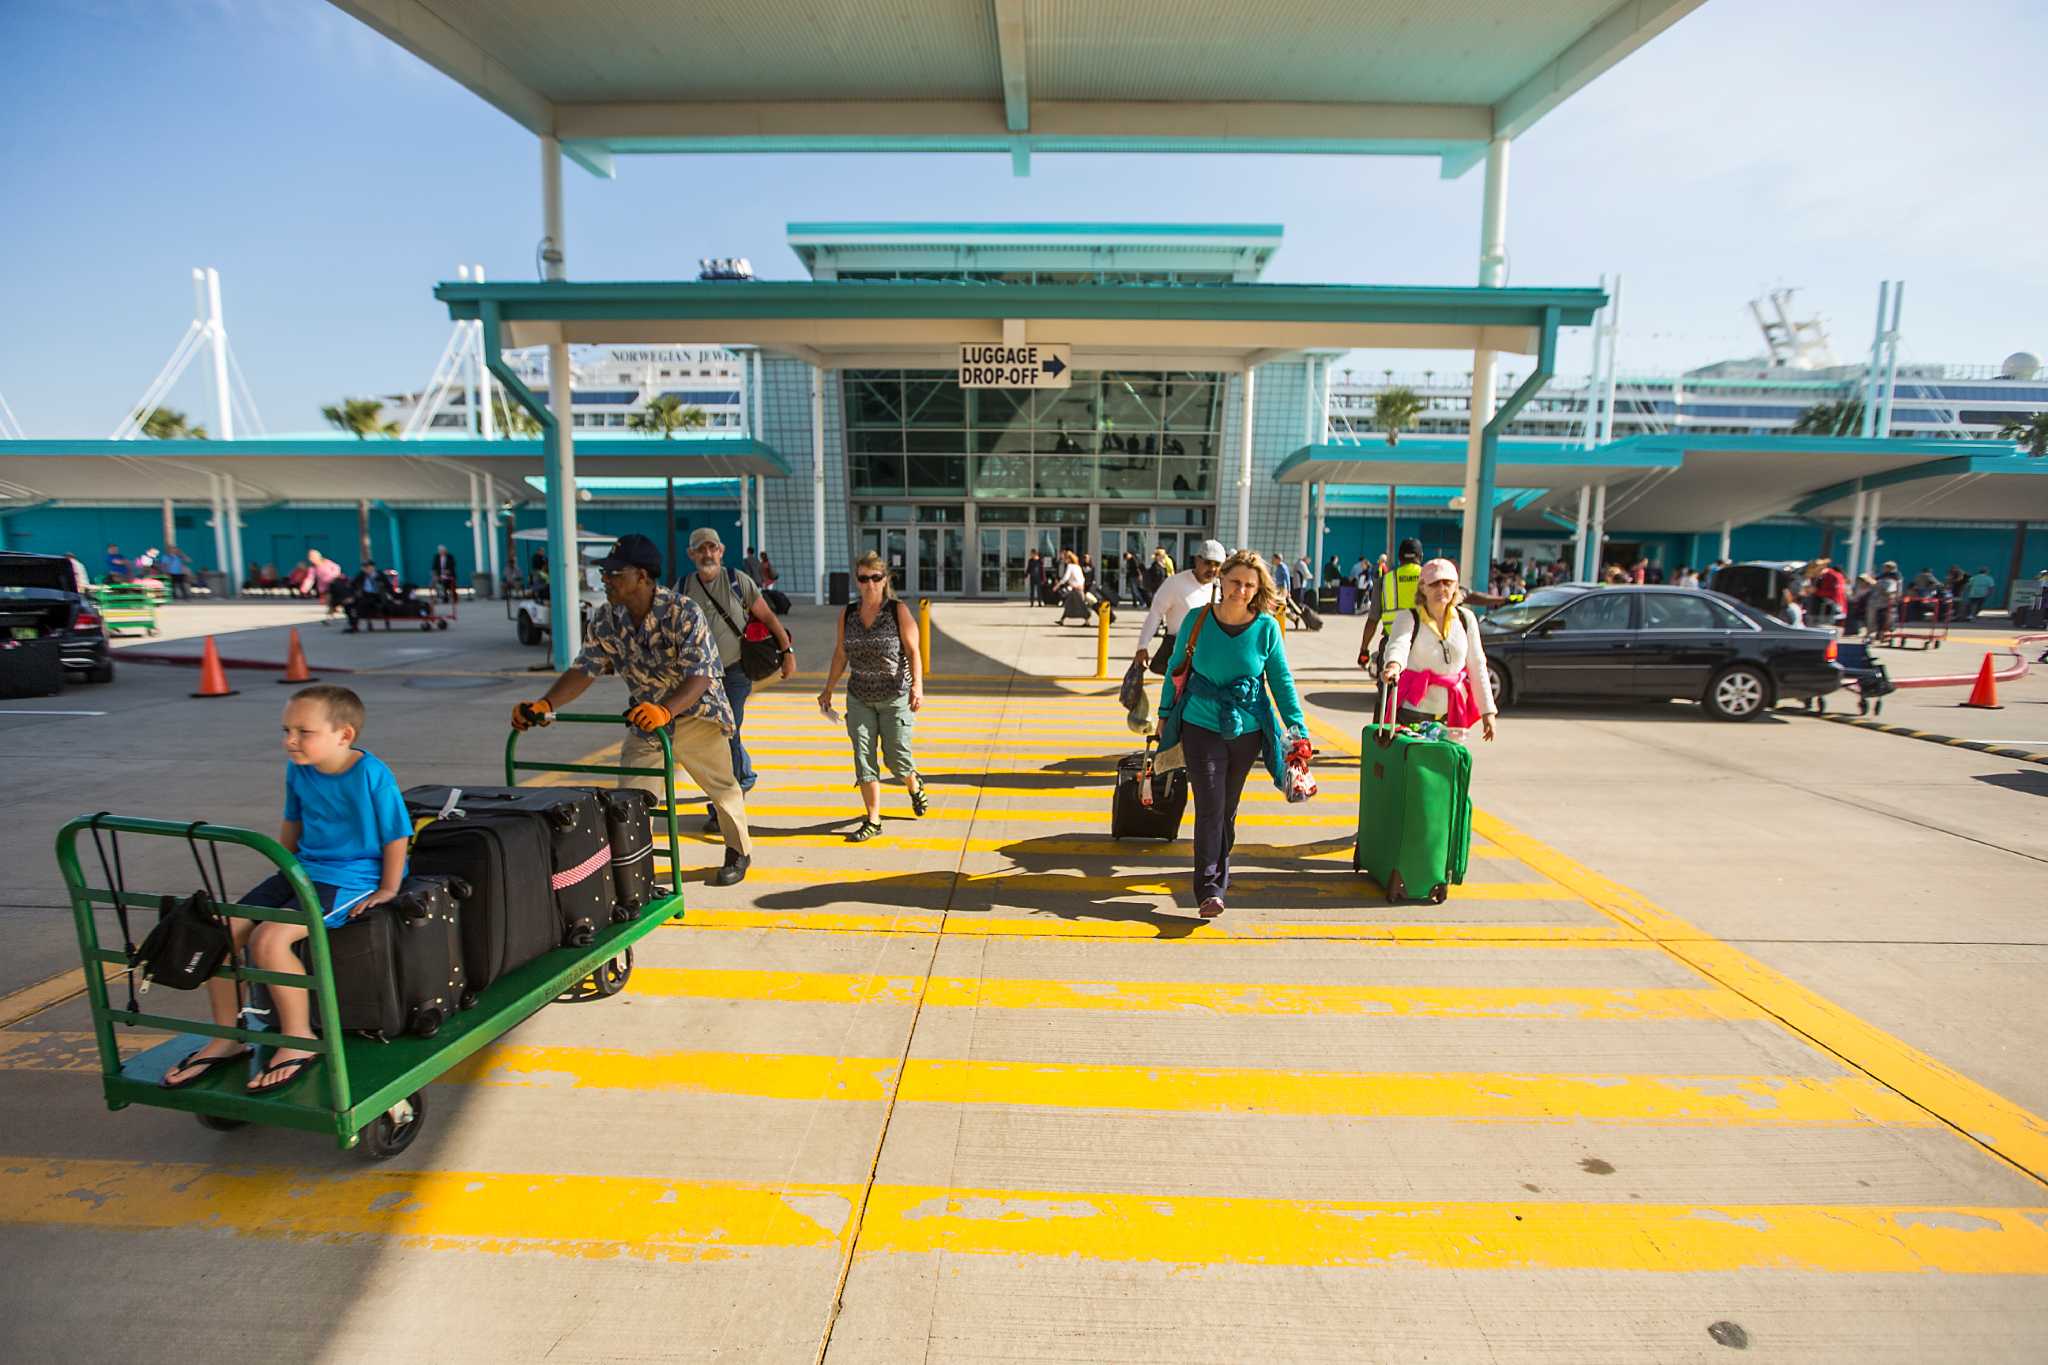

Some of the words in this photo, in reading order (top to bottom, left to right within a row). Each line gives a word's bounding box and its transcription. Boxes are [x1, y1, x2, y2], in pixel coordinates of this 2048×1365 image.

[611, 350, 692, 362] NORWEGIAN
[699, 350, 737, 364] JEWE
[962, 347, 1037, 364] LUGGAGE
[962, 367, 1039, 385] DROP-OFF
[1398, 575, 1419, 583] SECURITY
